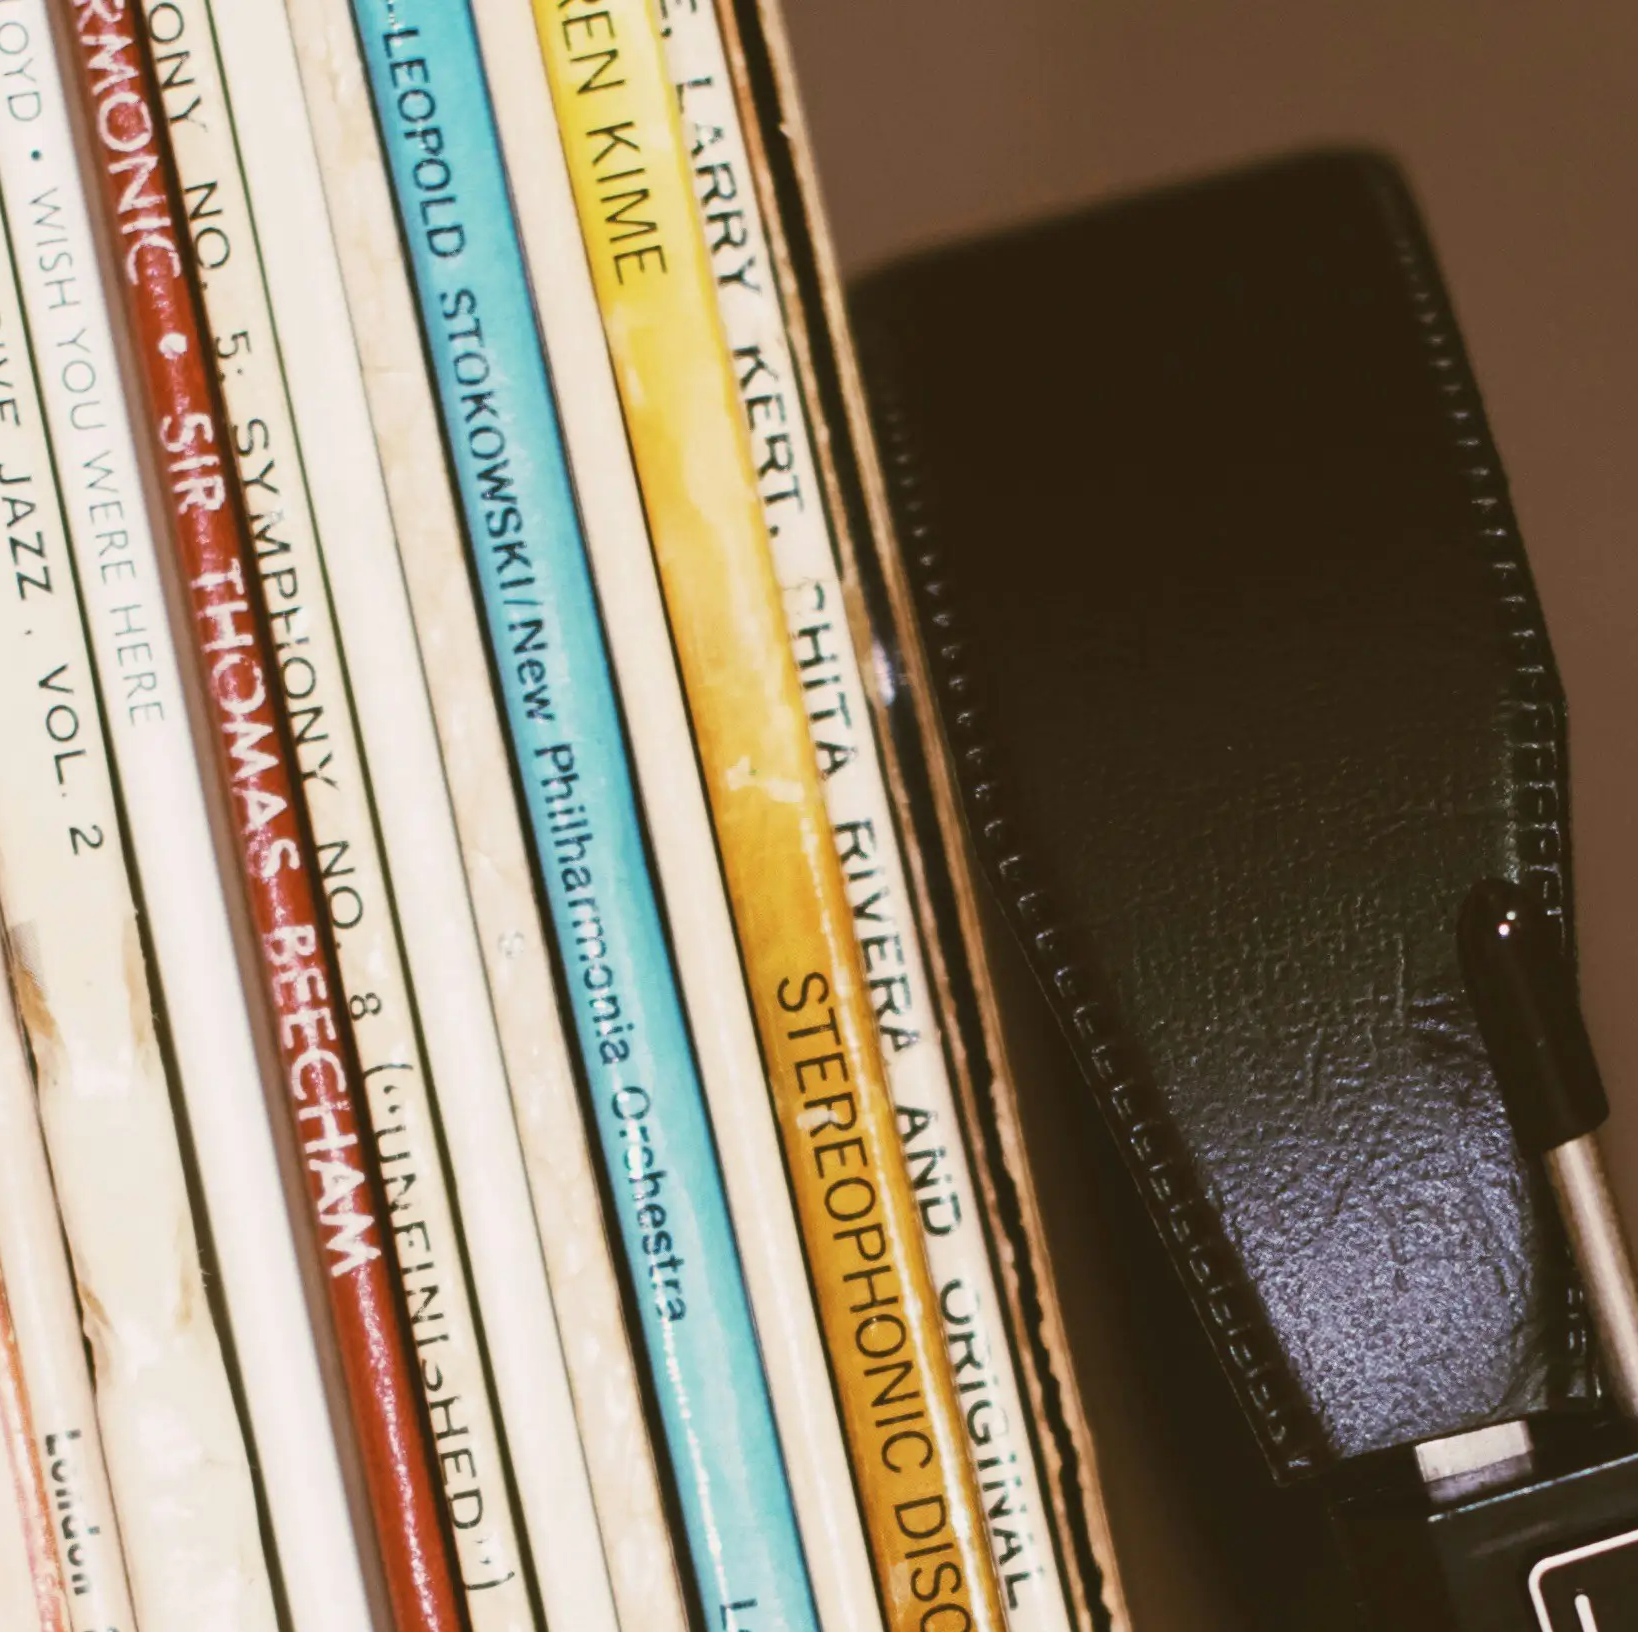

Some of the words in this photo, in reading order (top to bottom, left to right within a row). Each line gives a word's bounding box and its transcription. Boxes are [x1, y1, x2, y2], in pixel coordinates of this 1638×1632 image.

[22, 186, 82, 310] WISH
[583, 123, 671, 284] KIME
[50, 328, 107, 431] YOU
[155, 412, 229, 514] SIR
[75, 449, 138, 586] WERE
[177, 180, 239, 290] NO.
[225, 417, 341, 790] SYMPHONY
[310, 840, 372, 949] NO.
[342, 992, 384, 1021] 8
[105, 605, 166, 726] HERE
[181, 556, 304, 879] THOMAS
[377, 27, 470, 260] LEOPOLD
[530, 742, 641, 1067] Philharmonia
[608, 1086, 698, 1322] Orchestra
[33, 665, 95, 798] VOL.
[66, 823, 107, 856] 2
[671, 75, 761, 294] LARRY
[832, 820, 926, 1050] RIVERA
[894, 1104, 966, 1235] AND
[933, 1279, 1050, 1609] ORIGINAL
[256, 925, 387, 1278] BEECHAM
[771, 971, 938, 1473] STEREOPHONIC
[41, 1428, 114, 1594] London
